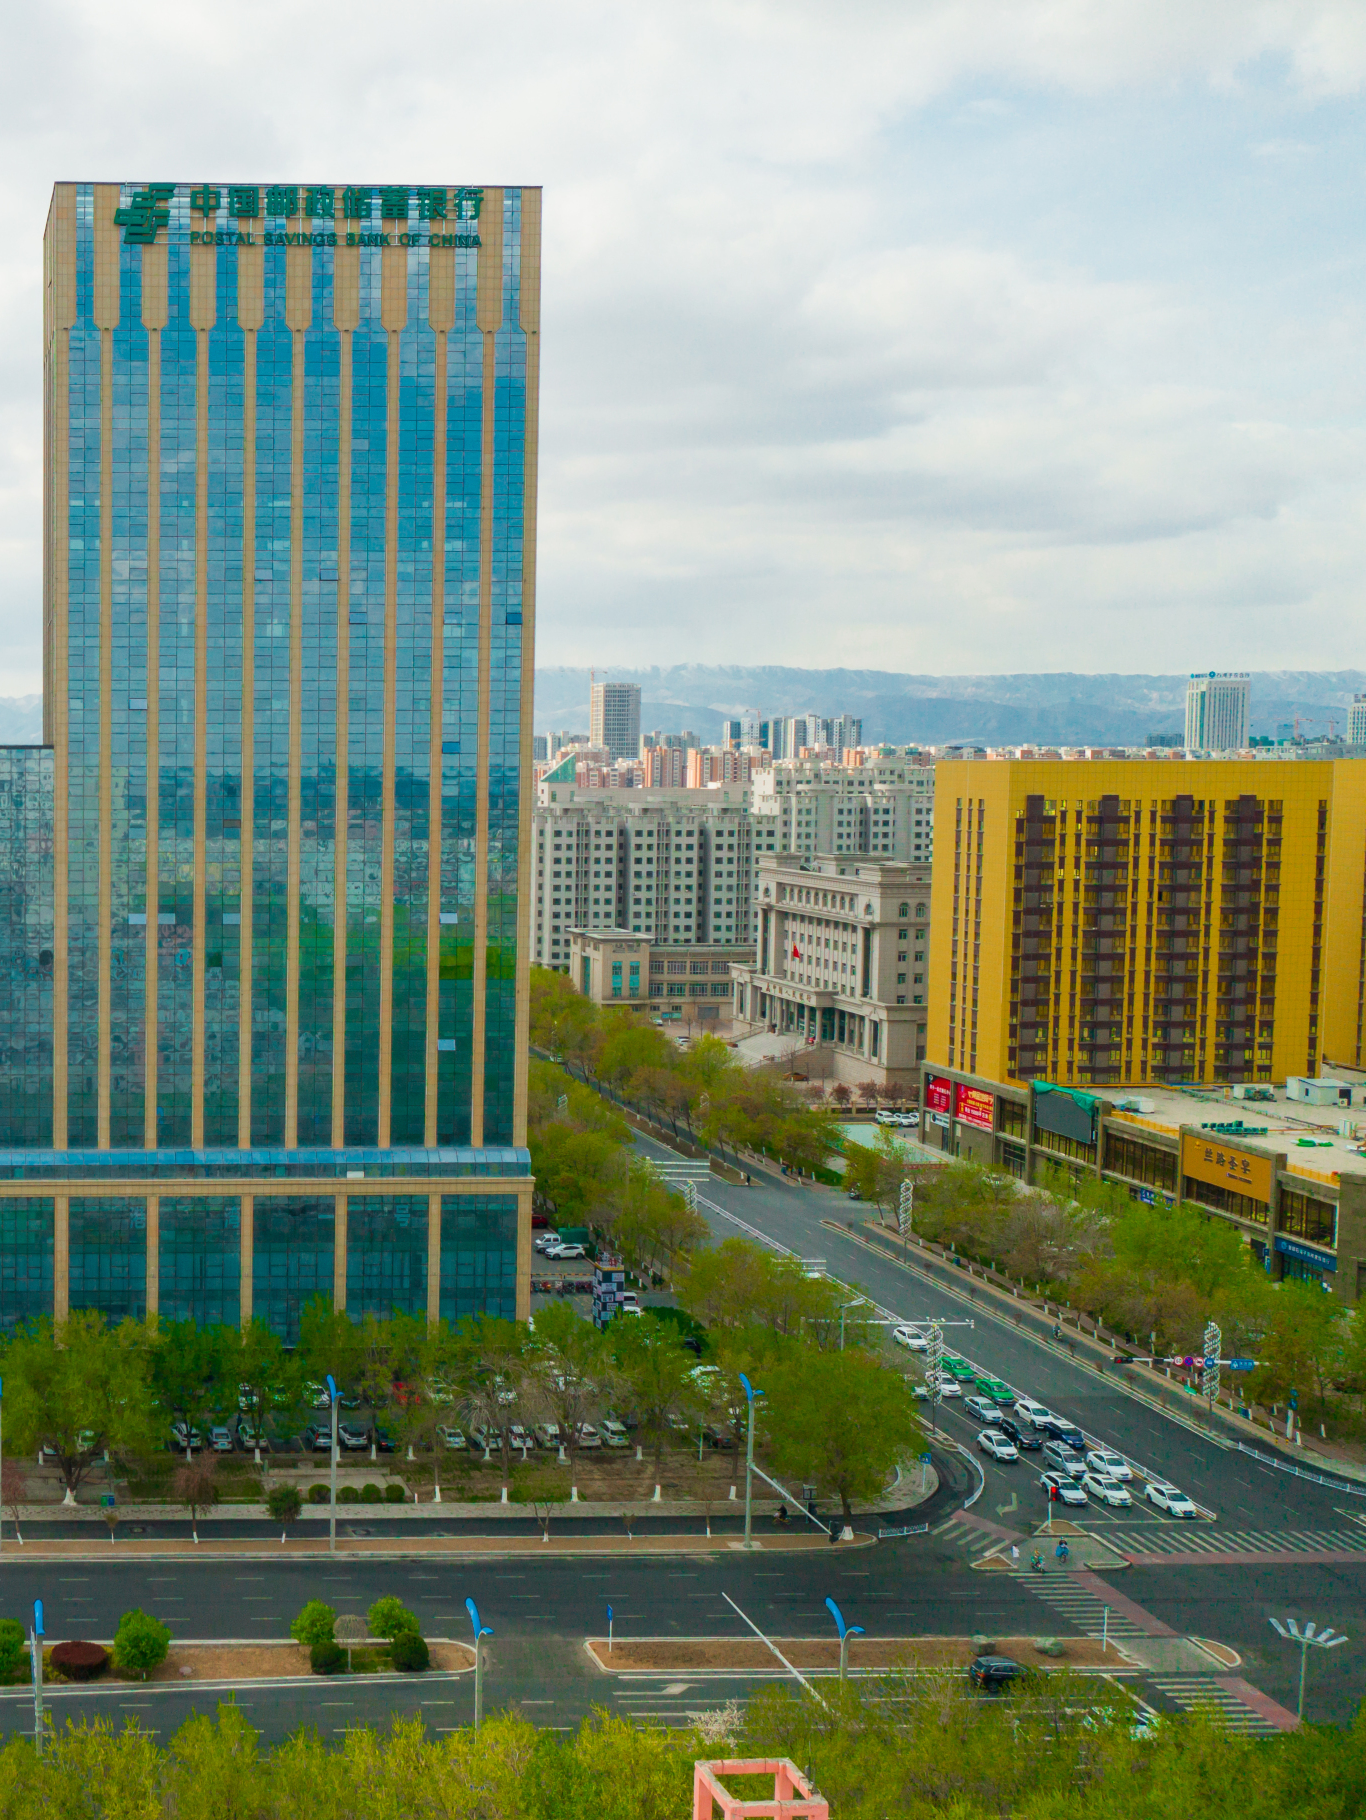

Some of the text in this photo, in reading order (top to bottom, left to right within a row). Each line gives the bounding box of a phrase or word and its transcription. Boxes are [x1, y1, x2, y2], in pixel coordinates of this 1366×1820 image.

[190, 184, 484, 220] 中国邮政储蓄银行
[190, 231, 482, 247] POSTAL SAVINGS BANK OF CHINA
